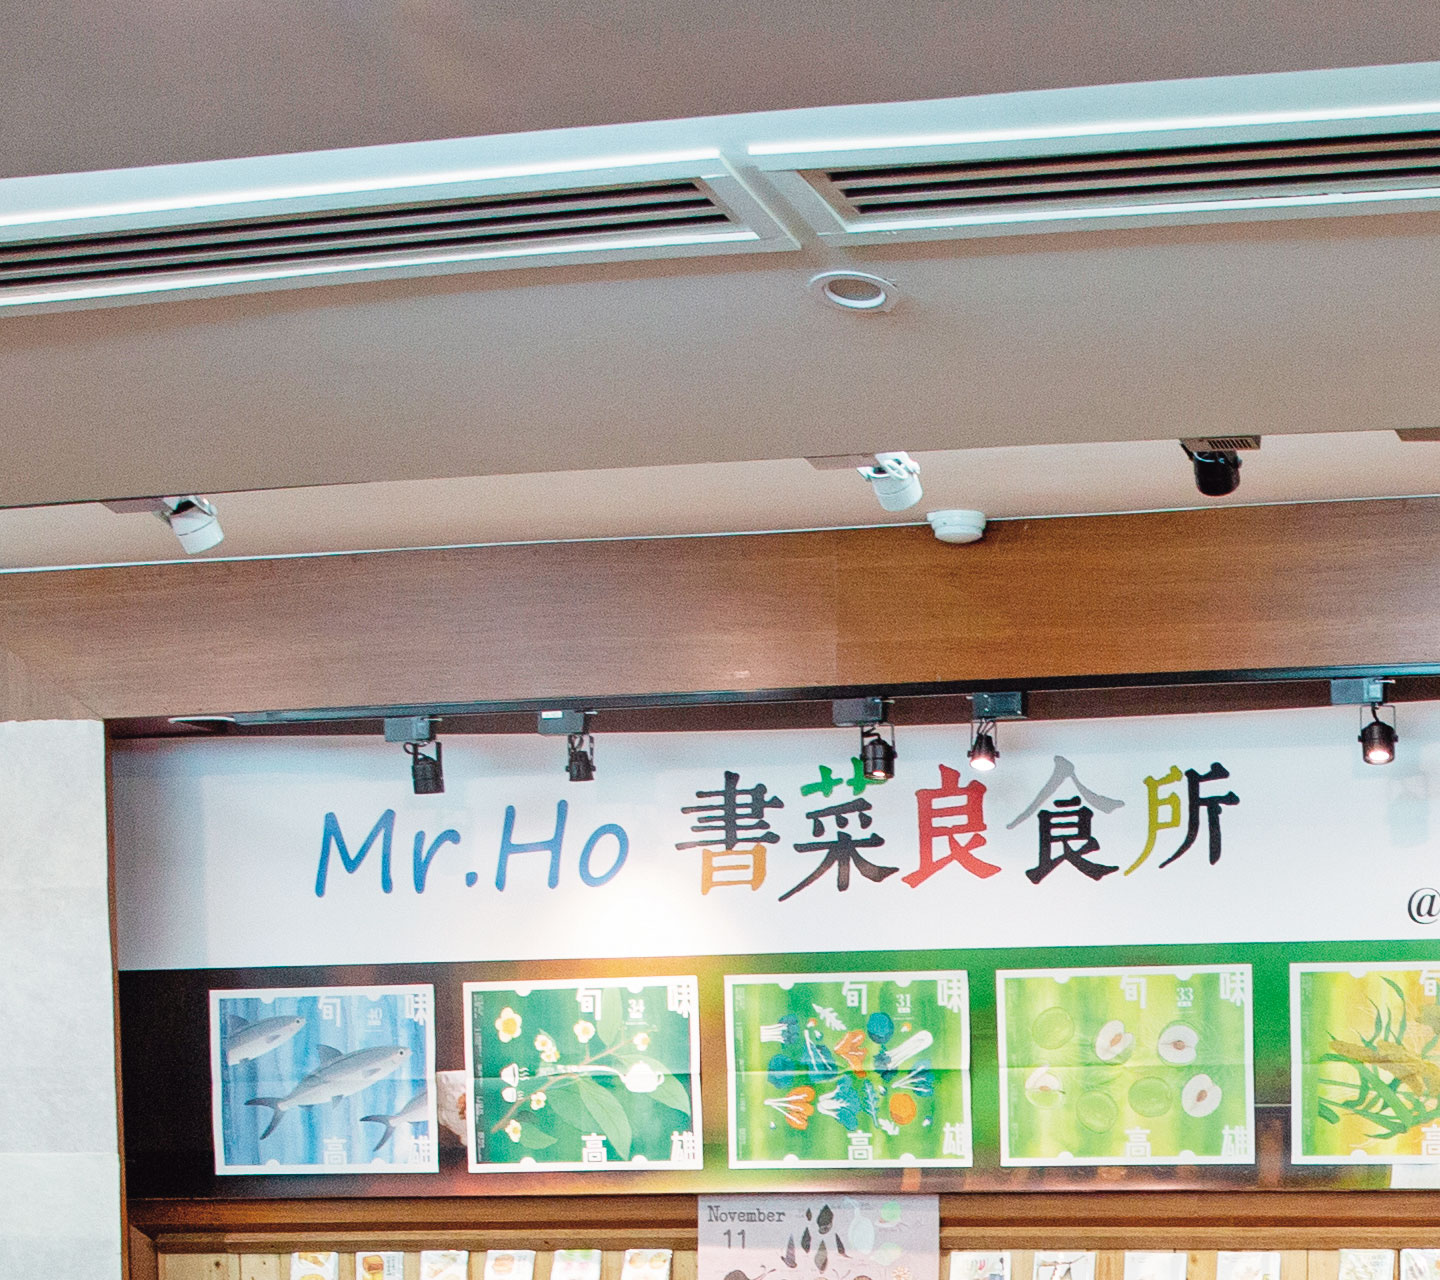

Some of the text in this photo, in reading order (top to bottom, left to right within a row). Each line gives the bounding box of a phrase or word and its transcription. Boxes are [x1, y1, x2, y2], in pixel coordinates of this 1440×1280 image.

[315, 756, 1240, 903] Mr.Ho 書菜良食所
[576, 987, 600, 1020] 旬
[843, 979, 868, 1014] 旬
[896, 993, 912, 1008] 31
[1119, 973, 1147, 1009] 旬
[1177, 987, 1194, 1001] 33
[319, 998, 342, 1027] 旬
[324, 1136, 347, 1164] 高
[582, 1132, 606, 1162] 高
[847, 1130, 874, 1160] 高
[1124, 1128, 1152, 1159] 高
[708, 1205, 786, 1223] November
[724, 1229, 747, 1249] 11
